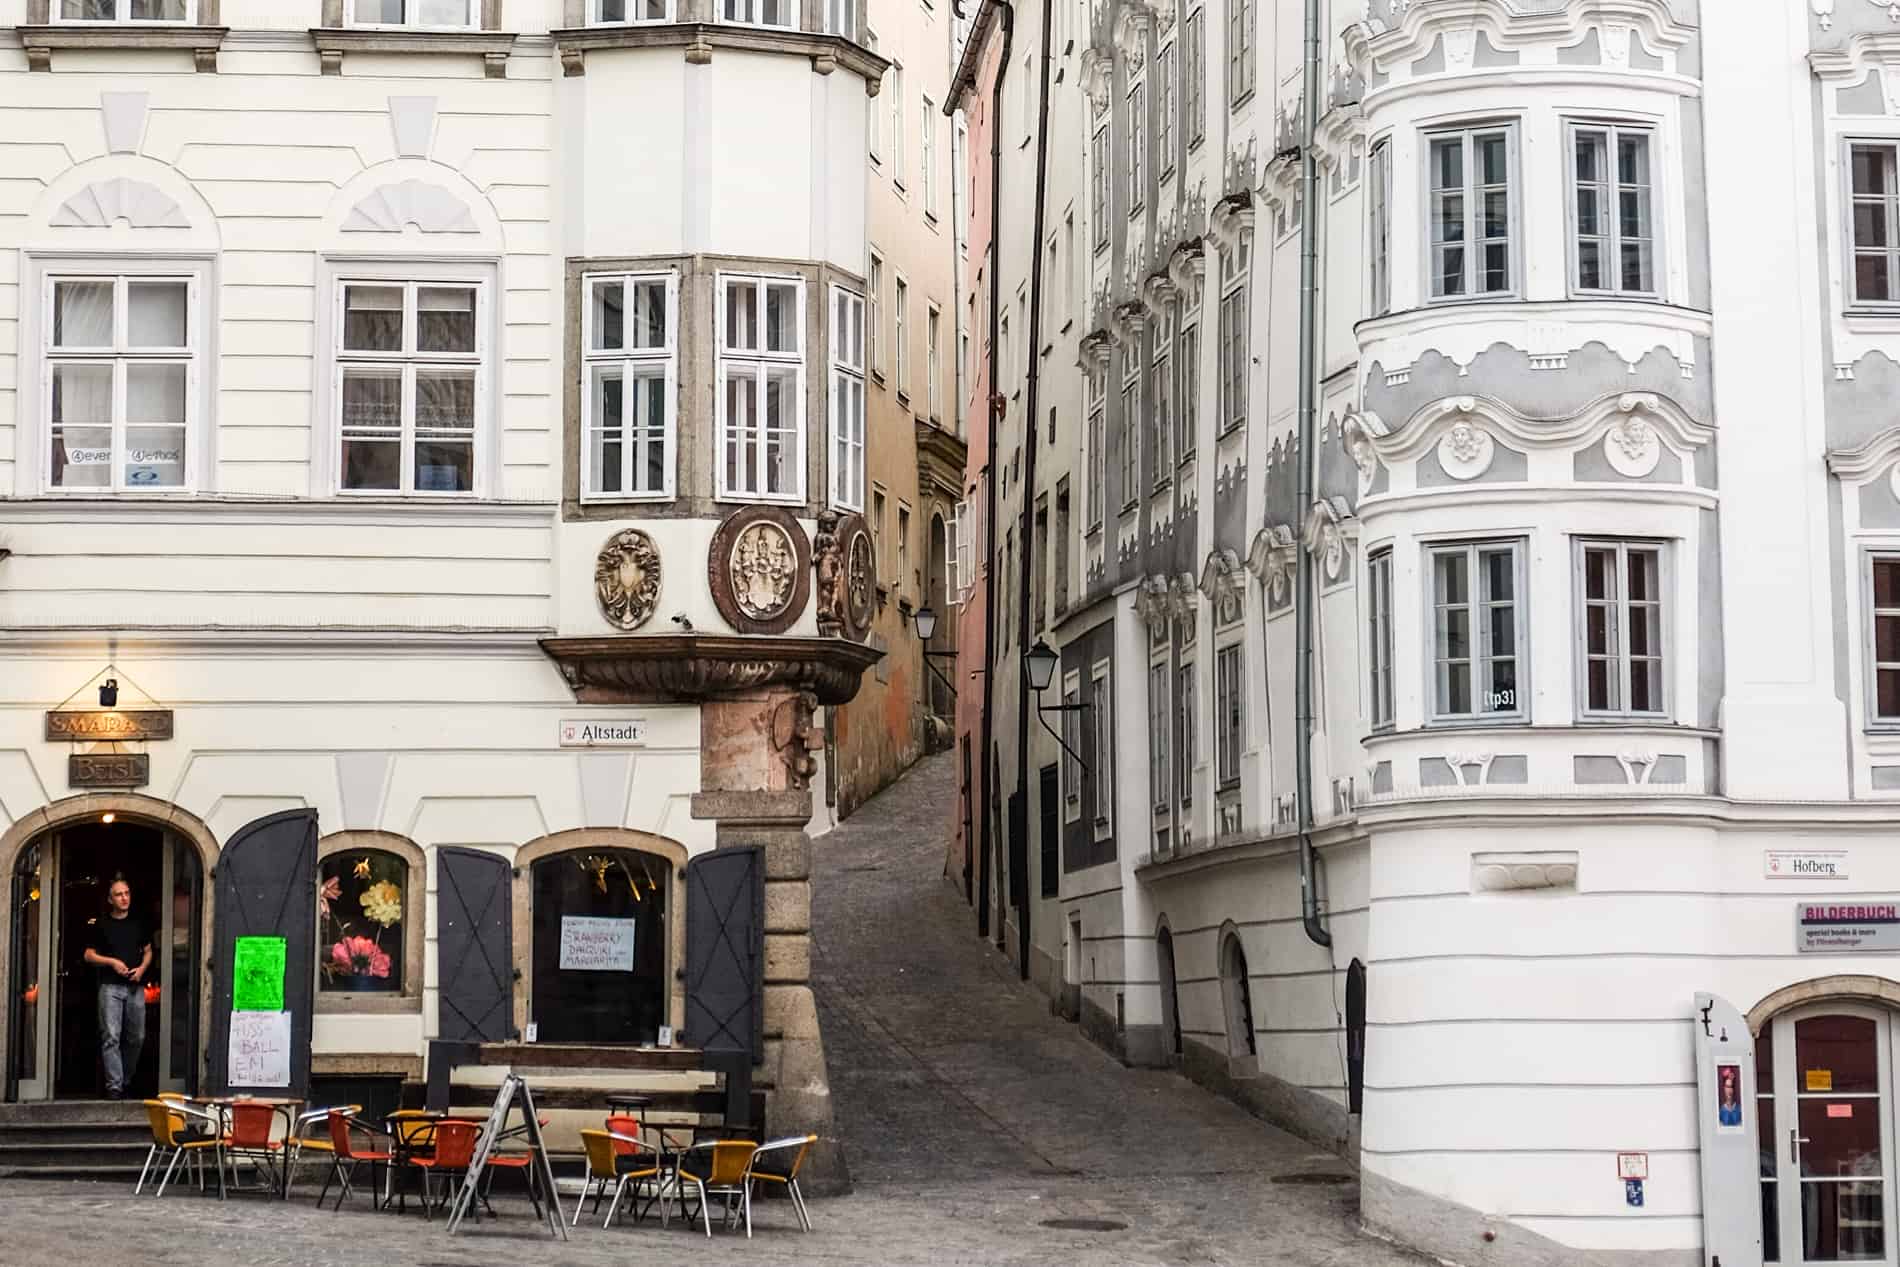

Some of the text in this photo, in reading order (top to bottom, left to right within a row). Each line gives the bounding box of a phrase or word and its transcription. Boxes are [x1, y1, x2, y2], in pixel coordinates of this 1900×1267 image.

[51, 717, 168, 733] SMARAGD
[582, 725, 637, 740] Altstadt
[1793, 859, 1836, 876] Hofberg
[1806, 906, 1896, 919] BILDERBUCH
